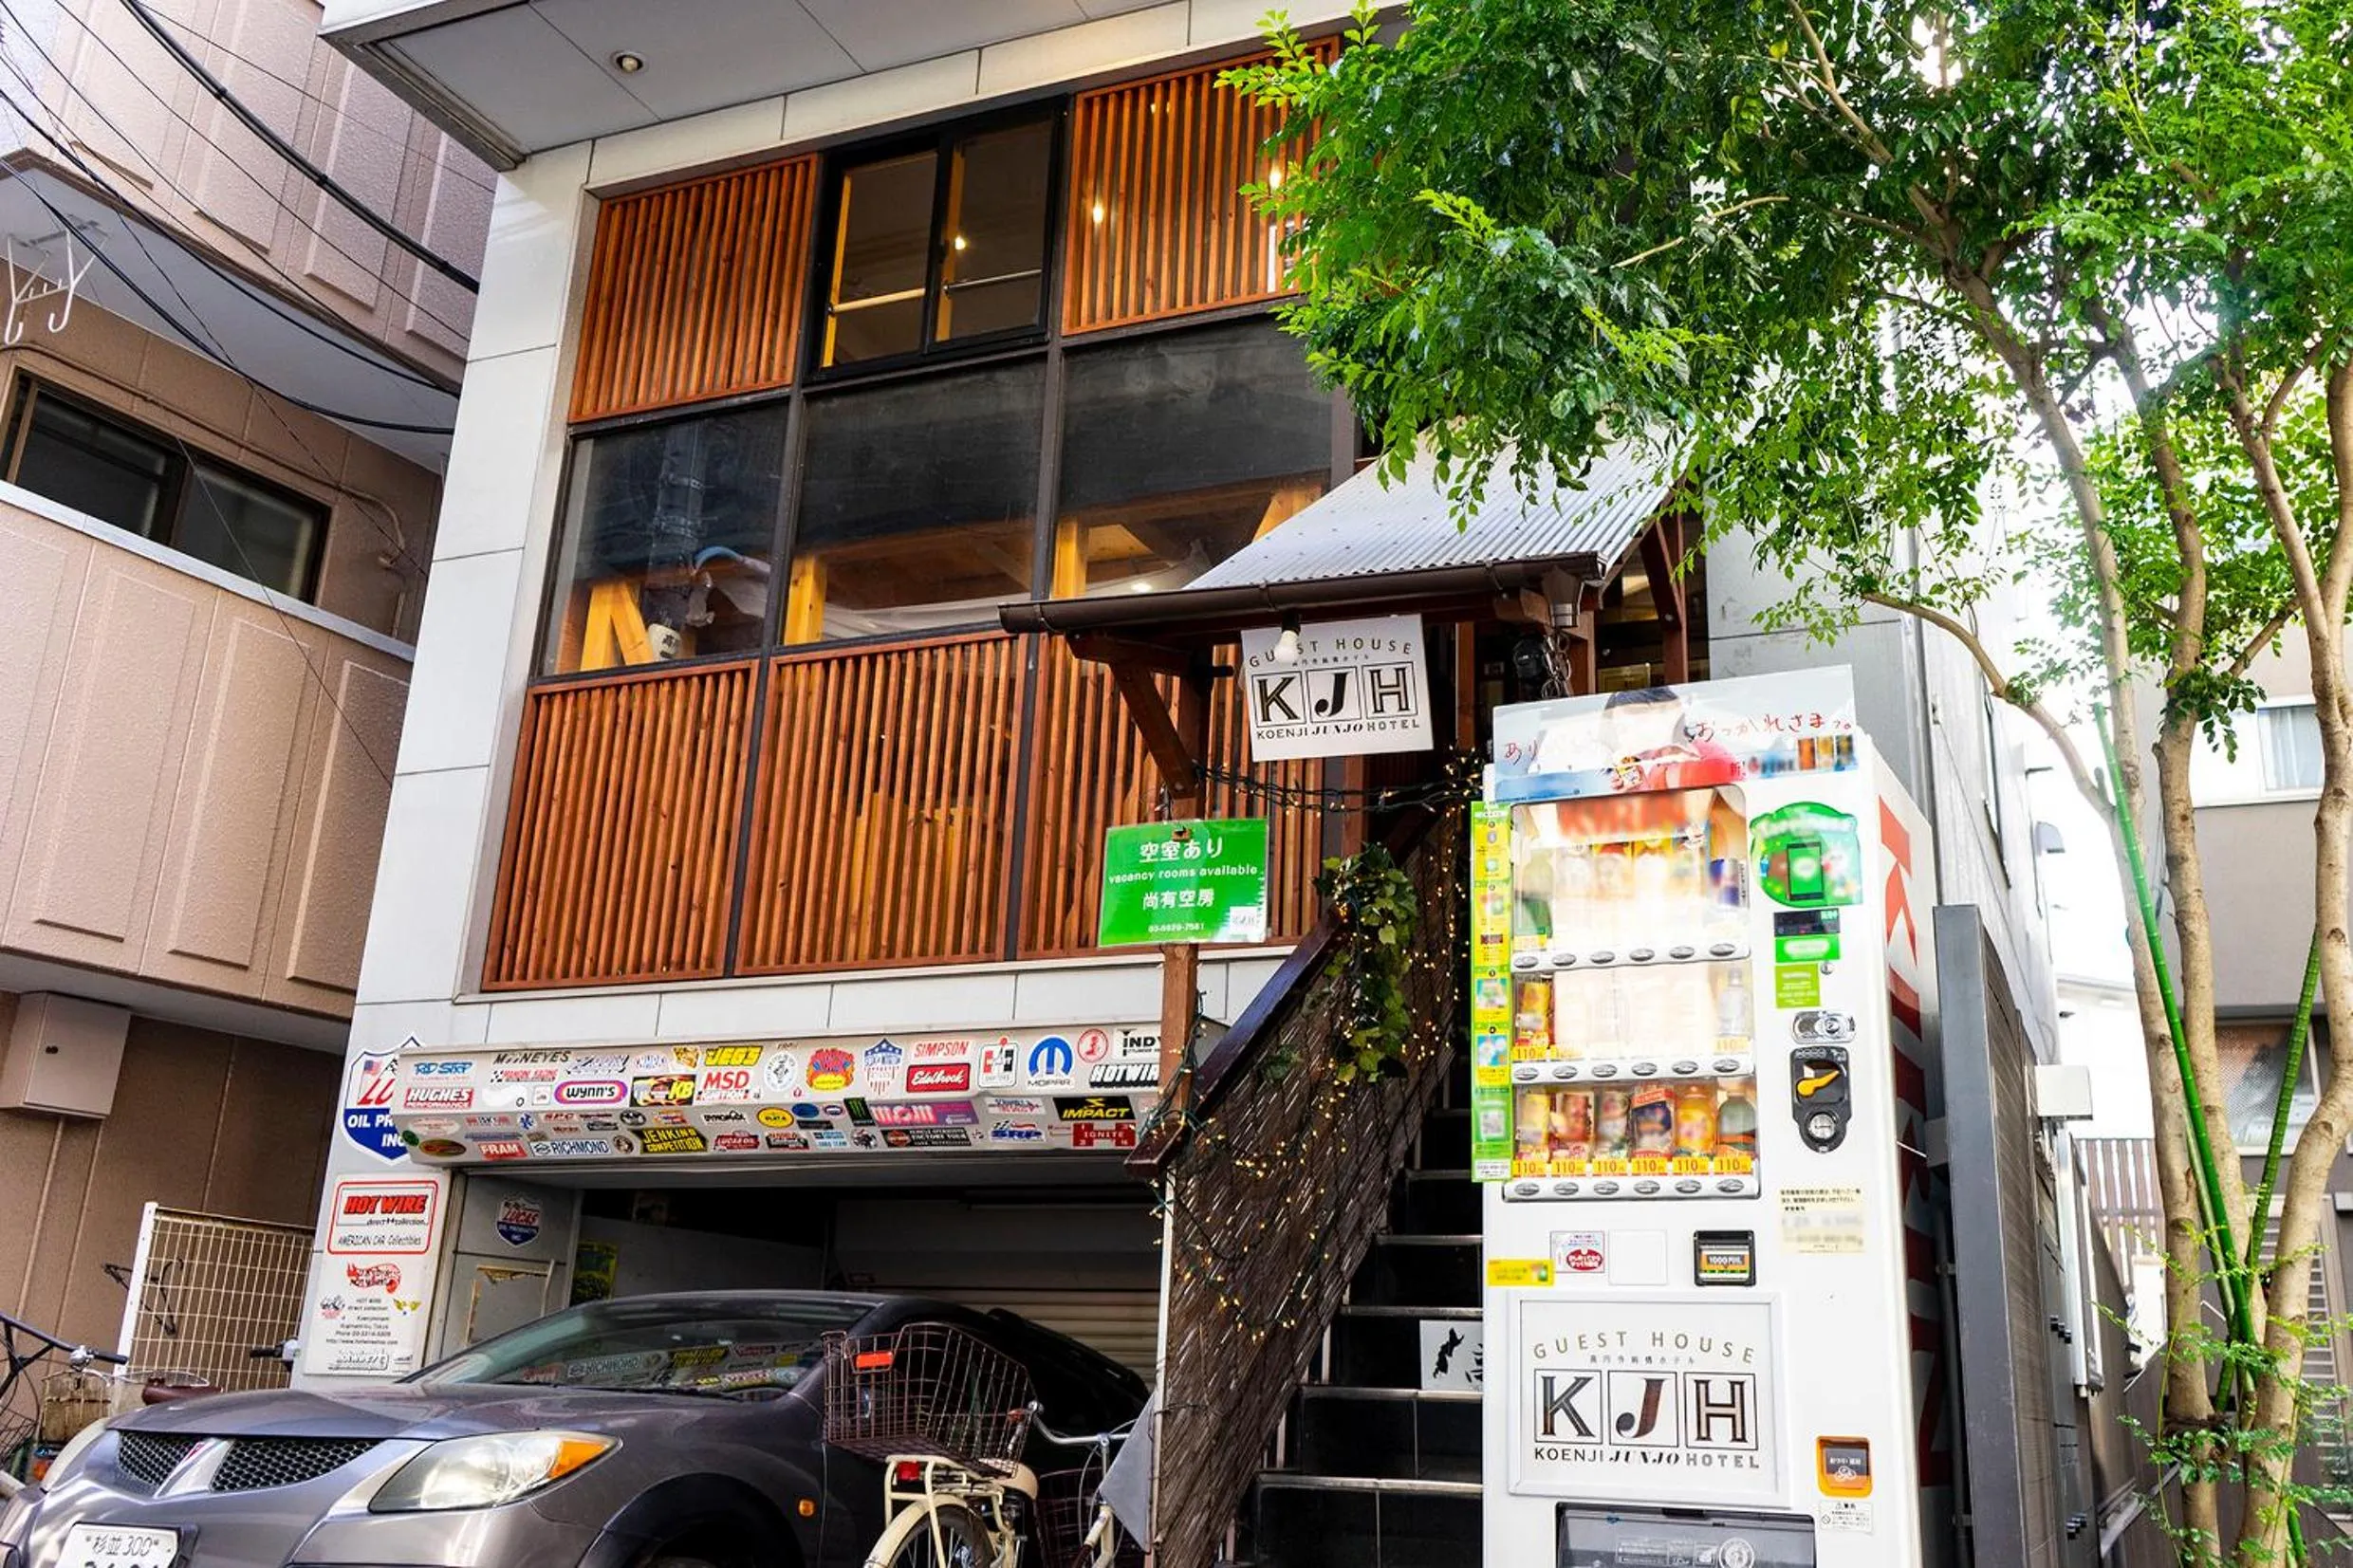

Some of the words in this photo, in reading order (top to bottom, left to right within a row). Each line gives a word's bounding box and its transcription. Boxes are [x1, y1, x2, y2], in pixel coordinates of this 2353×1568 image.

[1250, 639, 1318, 667] GUST
[1336, 637, 1412, 655] HOUSE
[1257, 727, 1307, 740] KOENJI
[1367, 718, 1420, 731] HOTEL
[1139, 837, 1223, 863] 空室あり
[1108, 870, 1155, 884] vacancy
[1158, 867, 1195, 879] rooms
[1199, 864, 1257, 877] available
[1142, 888, 1214, 911] 尚有空房
[915, 1041, 970, 1058] SIMPSON
[704, 1071, 750, 1089] MSD
[911, 1069, 964, 1085] Edelbrock
[408, 1087, 470, 1101] HUGHES
[669, 1081, 694, 1099] KB
[347, 1115, 371, 1128] OIL
[1063, 1107, 1129, 1119] IMPACT
[480, 1144, 519, 1155] FRAM
[550, 1140, 610, 1154] RICHMOND
[343, 1196, 380, 1214] HOT
[380, 1195, 428, 1214] WIRE
[1533, 1331, 1627, 1359] GUEST
[1652, 1332, 1755, 1363] HOUSE
[1534, 1448, 1603, 1463] KOENJI
[1686, 1453, 1760, 1468] HOTEL
[122, 1536, 153, 1557] 300
